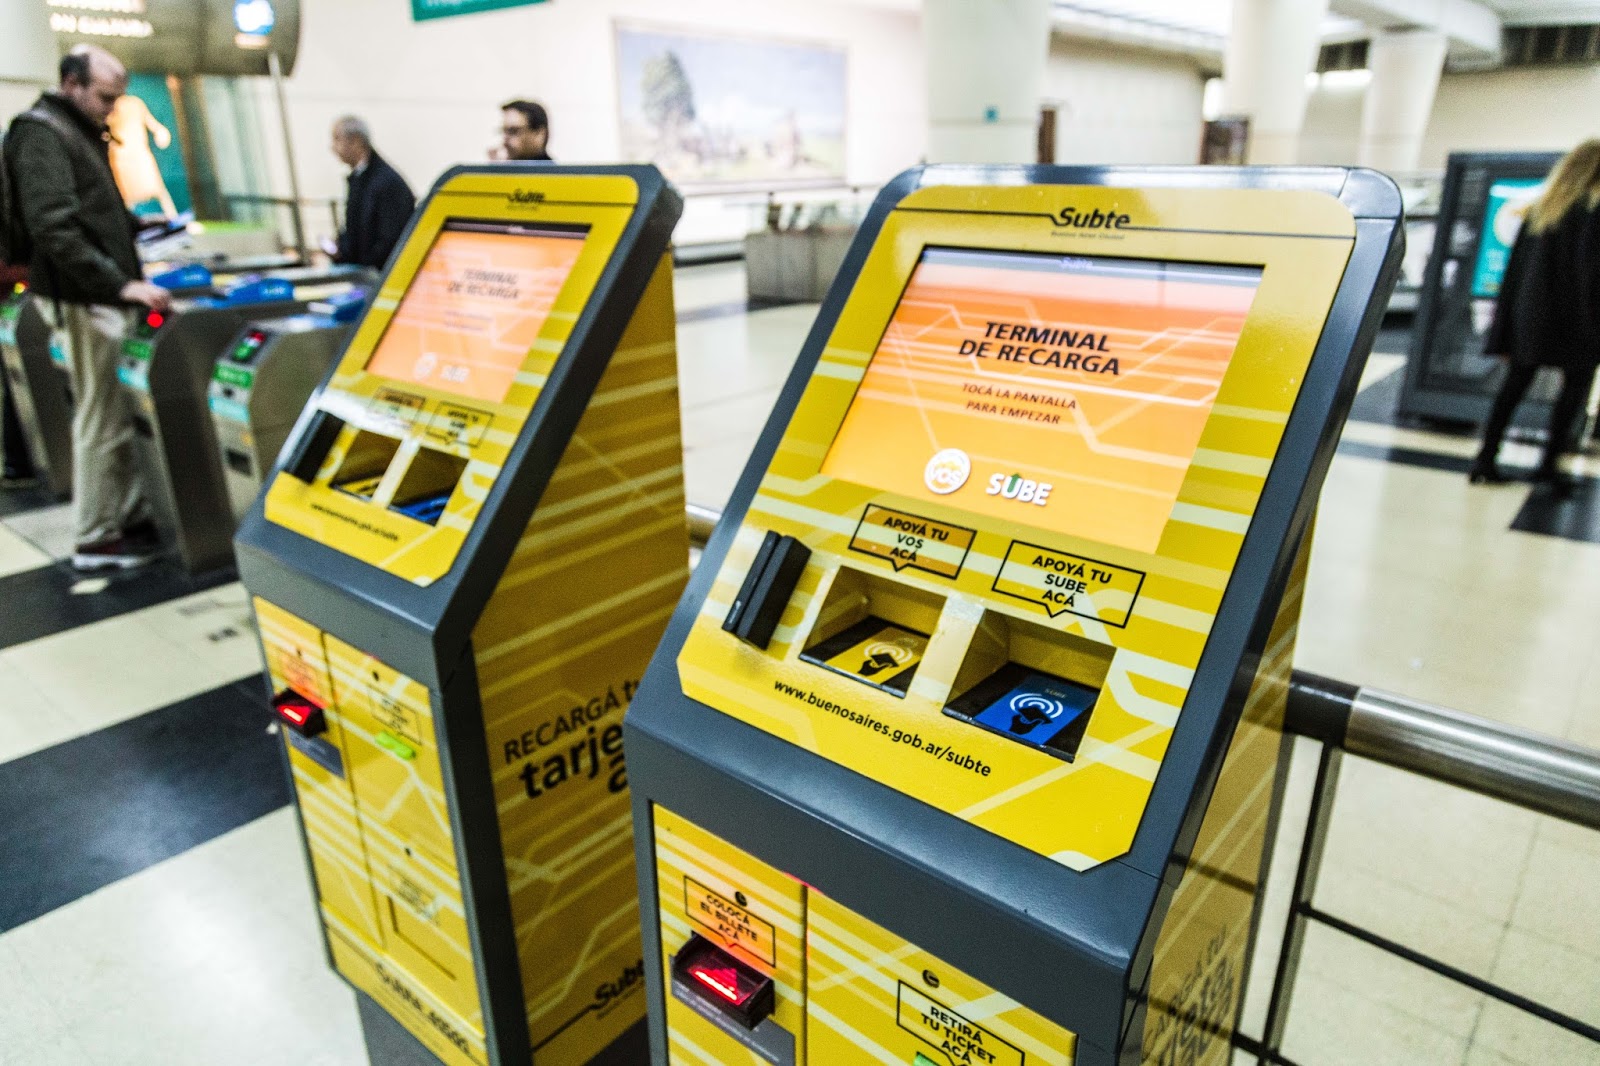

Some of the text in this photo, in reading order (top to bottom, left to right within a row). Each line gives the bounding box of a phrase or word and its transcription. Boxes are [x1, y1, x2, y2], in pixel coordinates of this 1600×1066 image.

[1055, 206, 1131, 229] Subte
[984, 321, 1111, 352] TERMINAL
[958, 339, 1120, 376] DE RECARGA
[962, 382, 1077, 410] TOCÁ LA PANTALLA
[966, 400, 1061, 425] PARA EMPEZAR
[985, 472, 1053, 506] SUBE
[883, 517, 950, 542] APOYÁ TU
[897, 533, 924, 550] VOS
[889, 547, 918, 562] ACÁ
[1031, 555, 1113, 584] APOYÁ TU
[1044, 573, 1088, 594] SUBE
[1041, 589, 1076, 608] ACÁ
[774, 680, 992, 778] www.buenosaires.gob.ar/subte
[700, 901, 758, 943] EL BILLETE
[706, 894, 751, 927] COLOCÁ
[718, 923, 740, 941] ACÁ
[920, 1013, 997, 1064] TU TICKET
[930, 1006, 983, 1045] RETIRÁ
[941, 1040, 972, 1065] ACÁ
